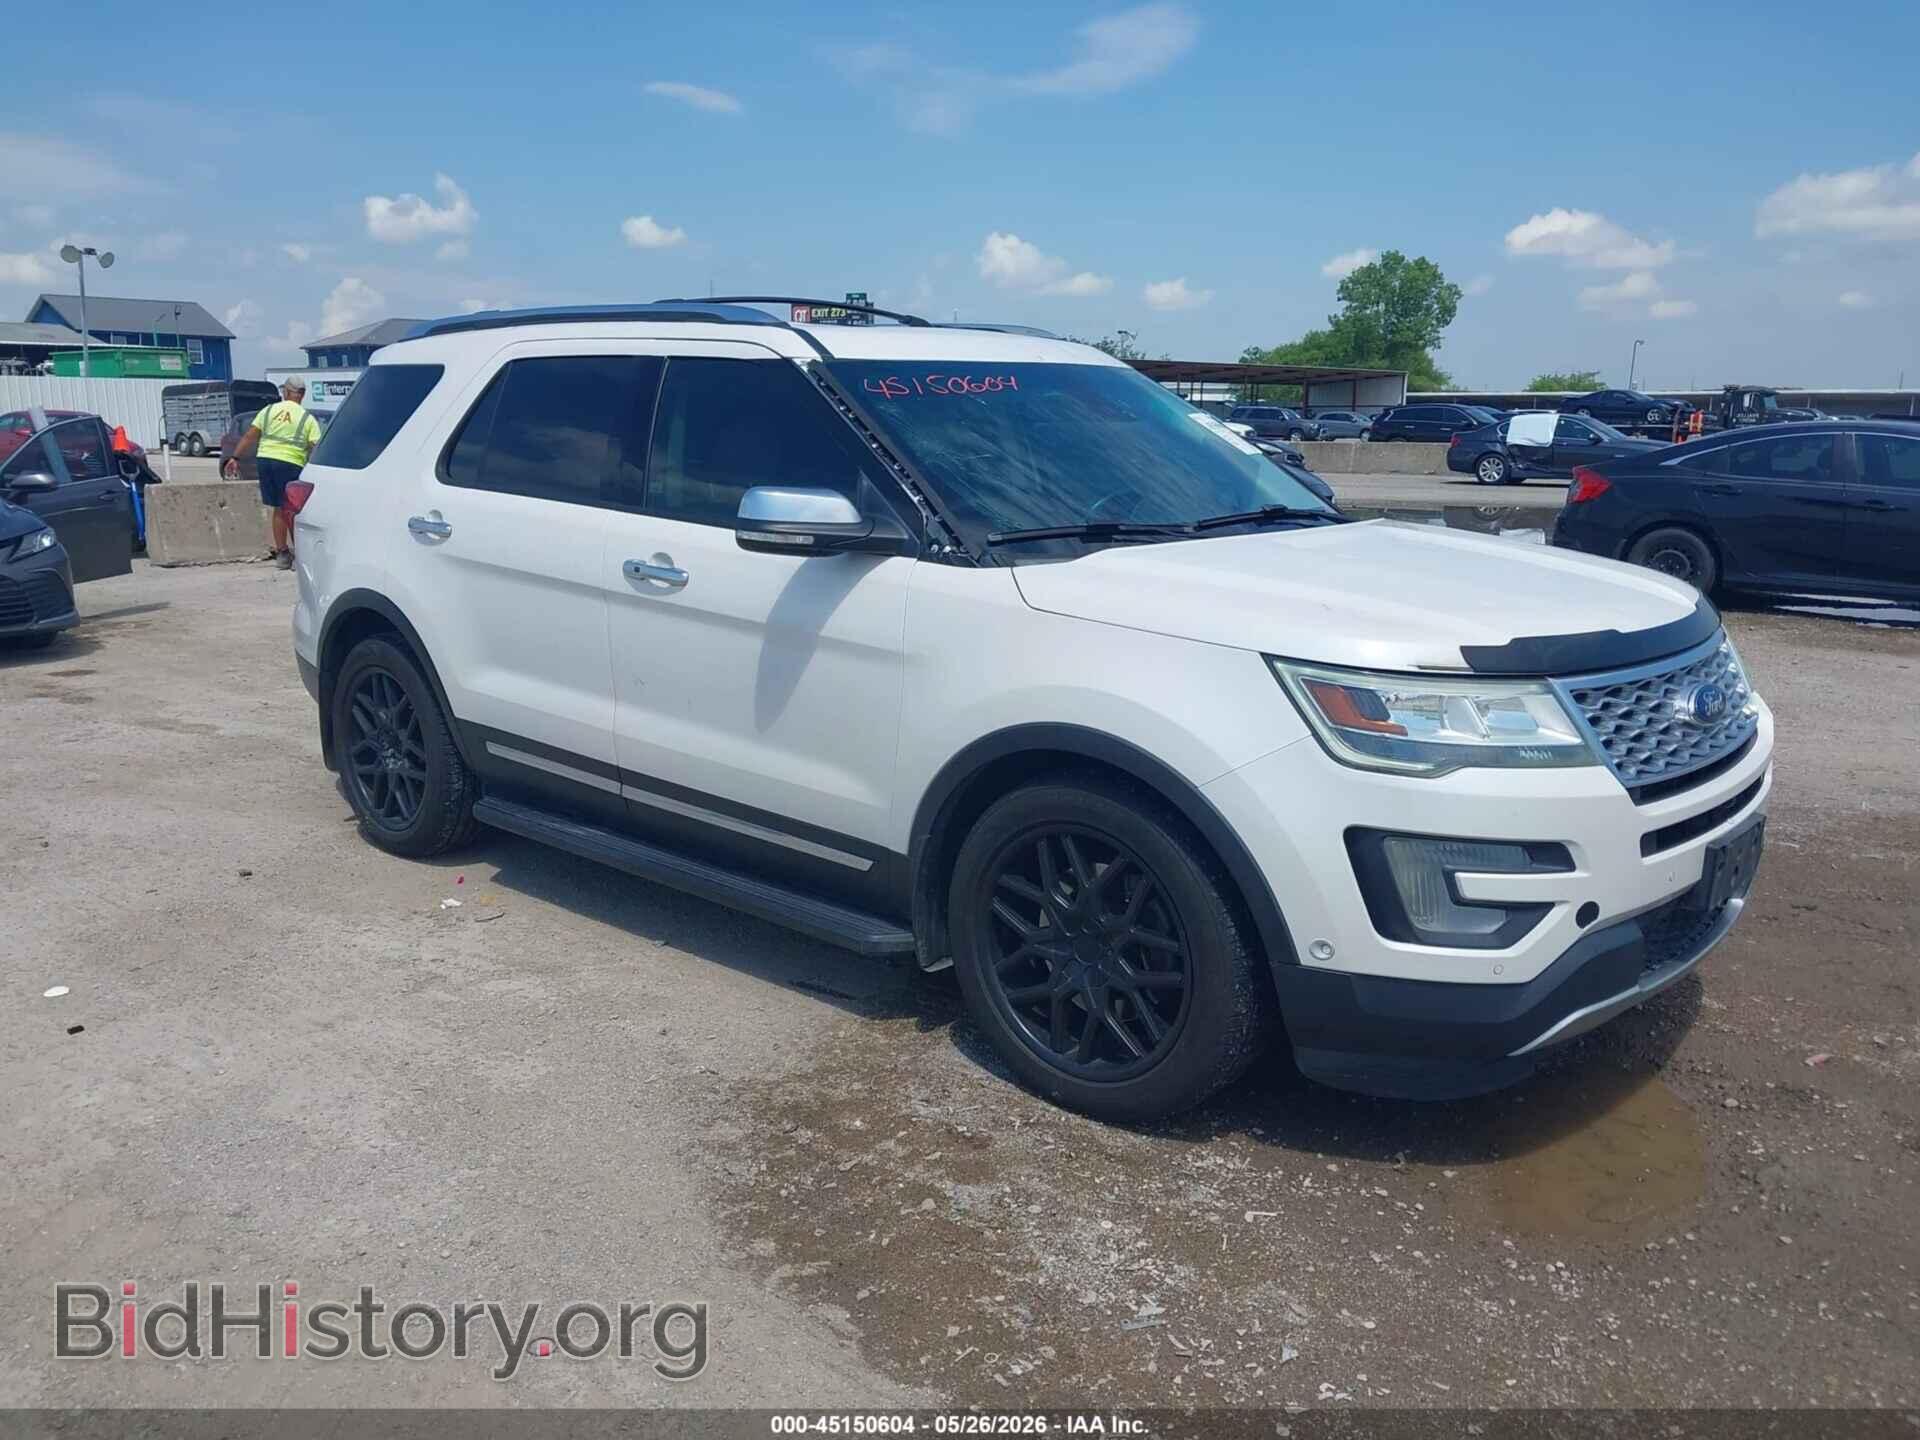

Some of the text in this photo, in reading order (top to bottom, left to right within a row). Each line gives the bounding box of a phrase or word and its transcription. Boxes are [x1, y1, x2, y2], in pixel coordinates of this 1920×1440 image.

[811, 307, 847, 318] EXIT 273
[863, 374, 1019, 400] 45150604
